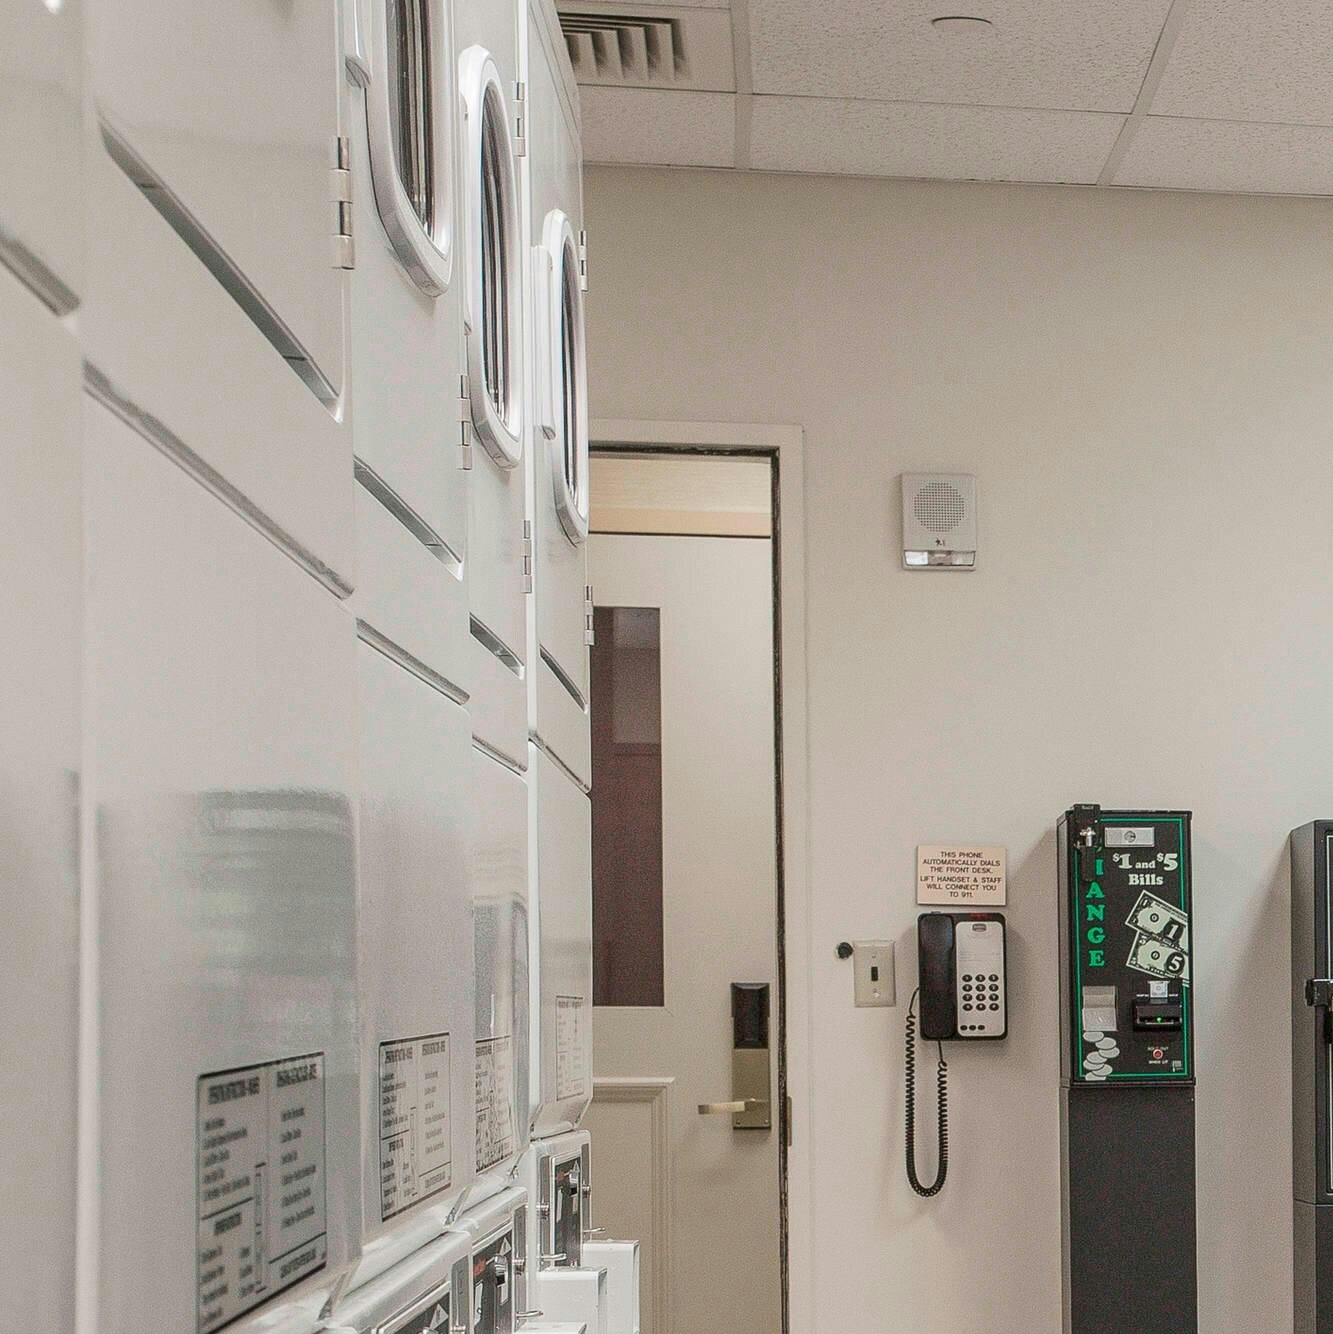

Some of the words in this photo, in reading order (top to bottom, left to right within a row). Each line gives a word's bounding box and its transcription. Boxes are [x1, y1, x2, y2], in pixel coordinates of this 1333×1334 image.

[1113, 853, 1133, 869] $1
[1135, 858, 1156, 869] and
[1157, 853, 1178, 871] $5
[1128, 874, 1164, 886] Bills
[1167, 923, 1179, 941] 1
[1169, 955, 1183, 973] 5
